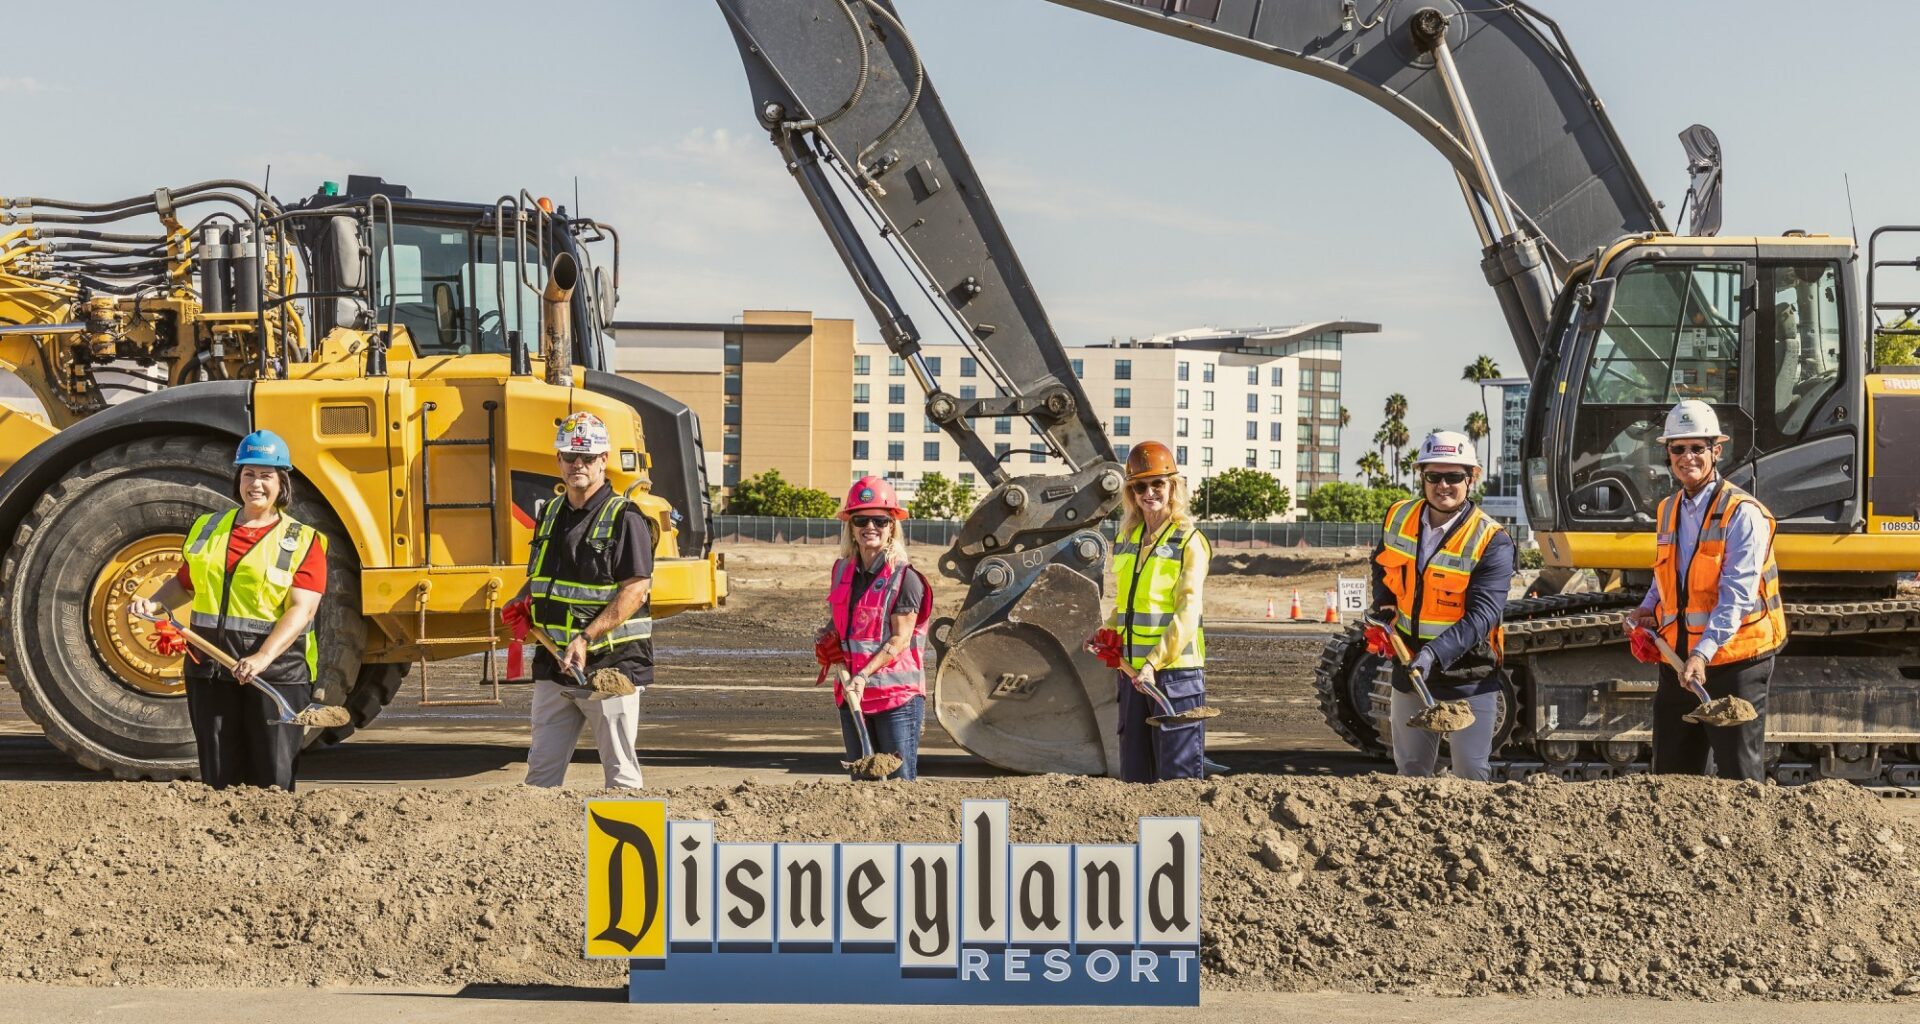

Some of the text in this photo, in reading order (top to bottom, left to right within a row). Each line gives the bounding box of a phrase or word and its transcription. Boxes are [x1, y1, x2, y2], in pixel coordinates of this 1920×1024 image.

[1882, 522, 1920, 531] 108930
[1345, 596, 1362, 608] 15
[589, 807, 1191, 957] Disneyland
[961, 948, 1196, 982] RESORT
